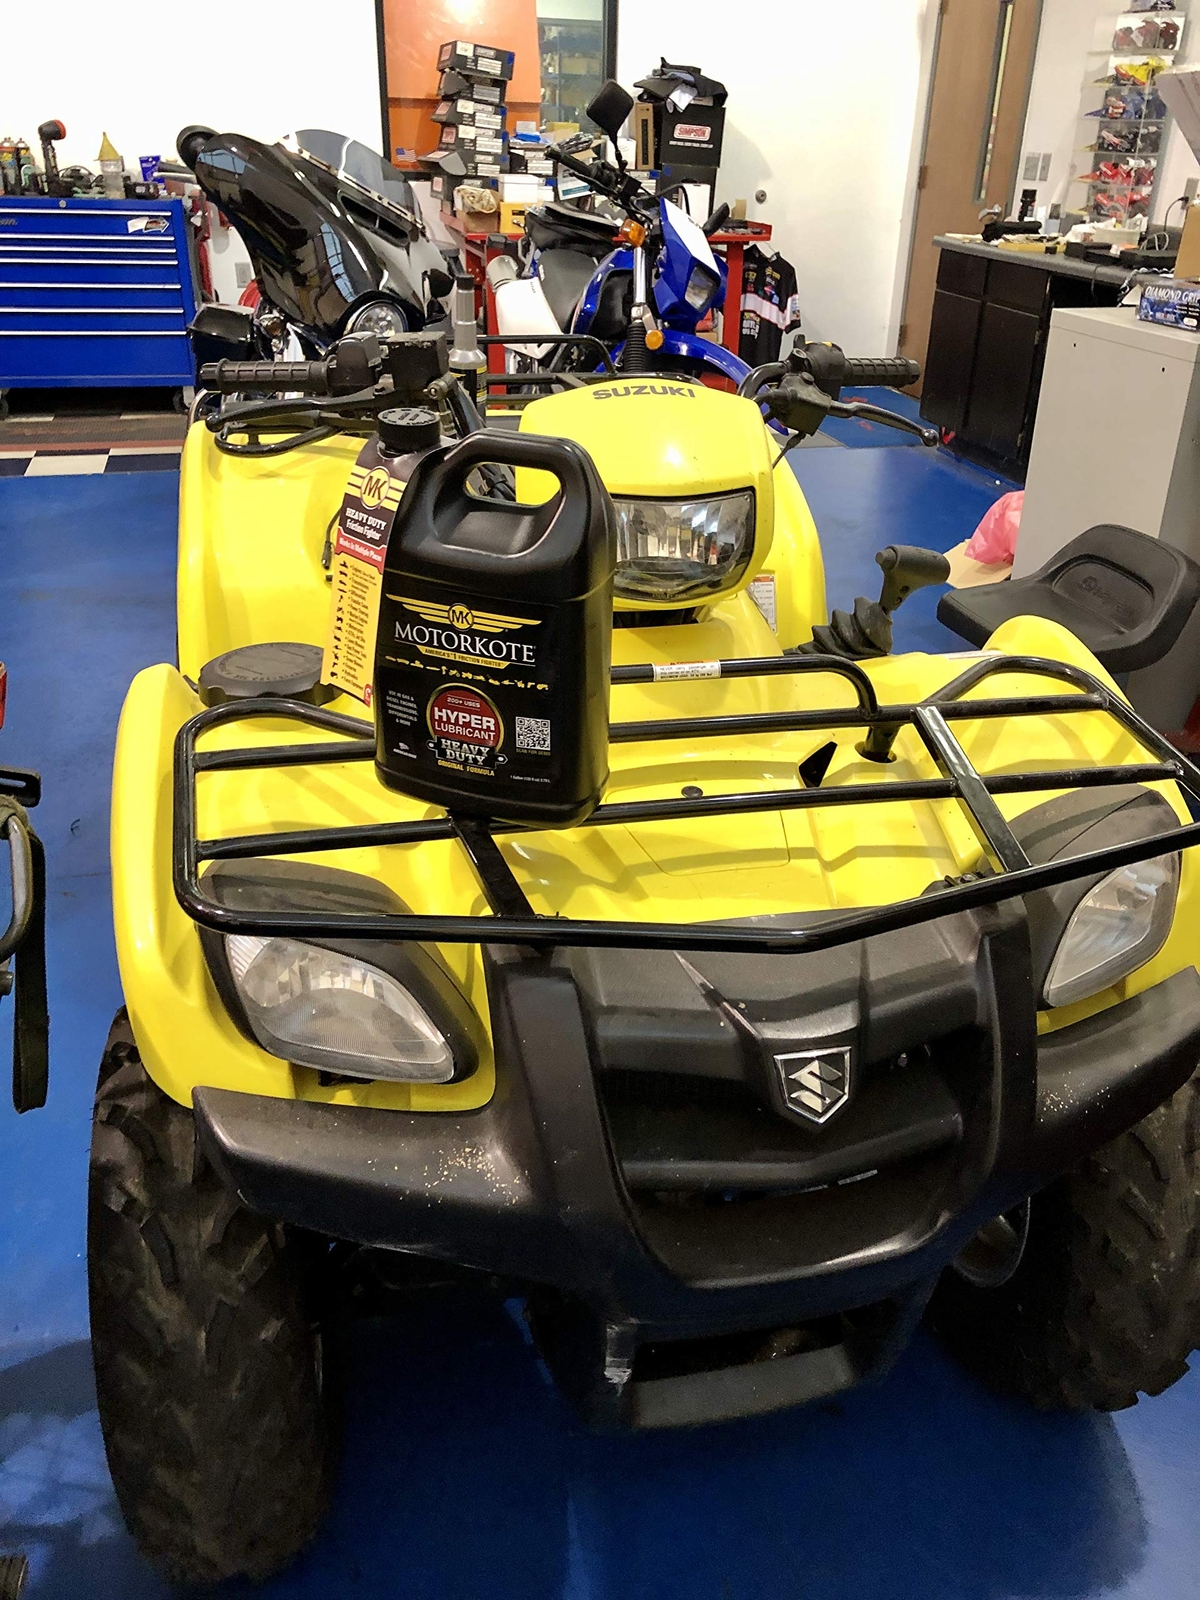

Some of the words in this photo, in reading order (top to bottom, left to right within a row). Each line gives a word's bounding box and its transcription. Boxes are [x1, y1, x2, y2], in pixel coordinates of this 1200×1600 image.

[1145, 286, 1182, 300] DIAMOND
[592, 385, 696, 400] SUZUKI
[363, 475, 388, 501] MK
[345, 507, 368, 523] HEAVY
[367, 515, 387, 530] DUTY
[346, 518, 364, 534] Friction
[364, 526, 382, 540] Fighter
[452, 609, 470, 625] MK
[394, 621, 536, 663] MOTORKOTE
[458, 654, 480, 664] FRICTION
[464, 700, 480, 708] USES
[434, 707, 495, 730] HYPER
[435, 721, 496, 741] LUBRICANT
[440, 738, 490, 757] HEAVY
[446, 750, 486, 766] DUTY
[437, 759, 464, 771] ORIGINAL
[466, 765, 495, 776] FORMULA
